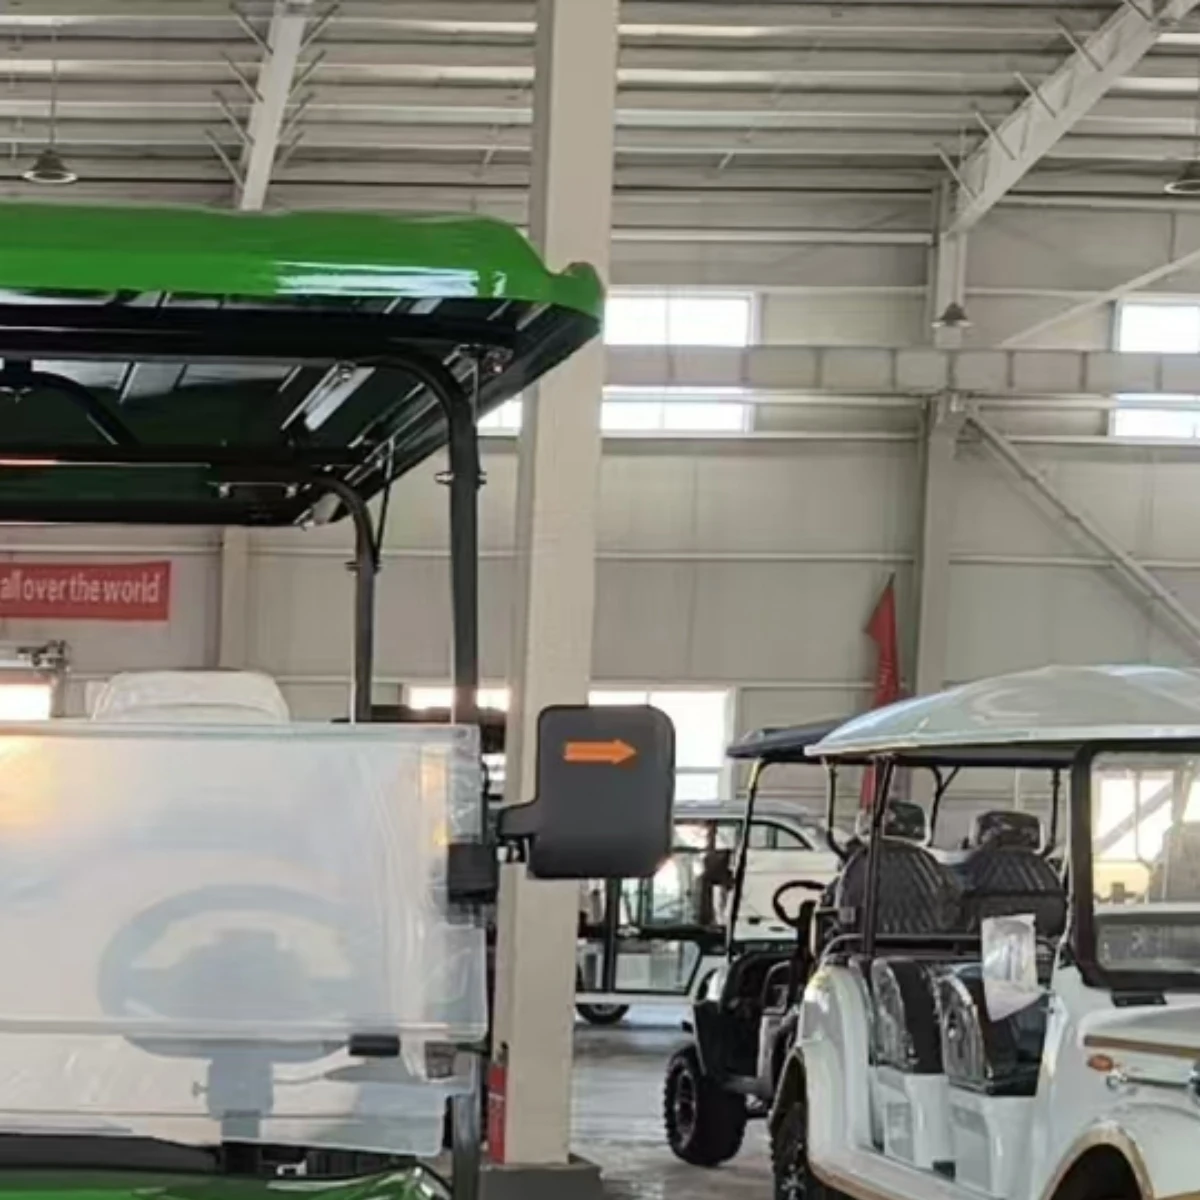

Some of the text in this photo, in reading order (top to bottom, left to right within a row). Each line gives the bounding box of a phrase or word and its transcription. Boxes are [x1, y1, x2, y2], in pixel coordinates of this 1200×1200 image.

[1, 569, 22, 600] all
[23, 577, 68, 601] over
[69, 572, 101, 602] the
[103, 572, 161, 604] world
